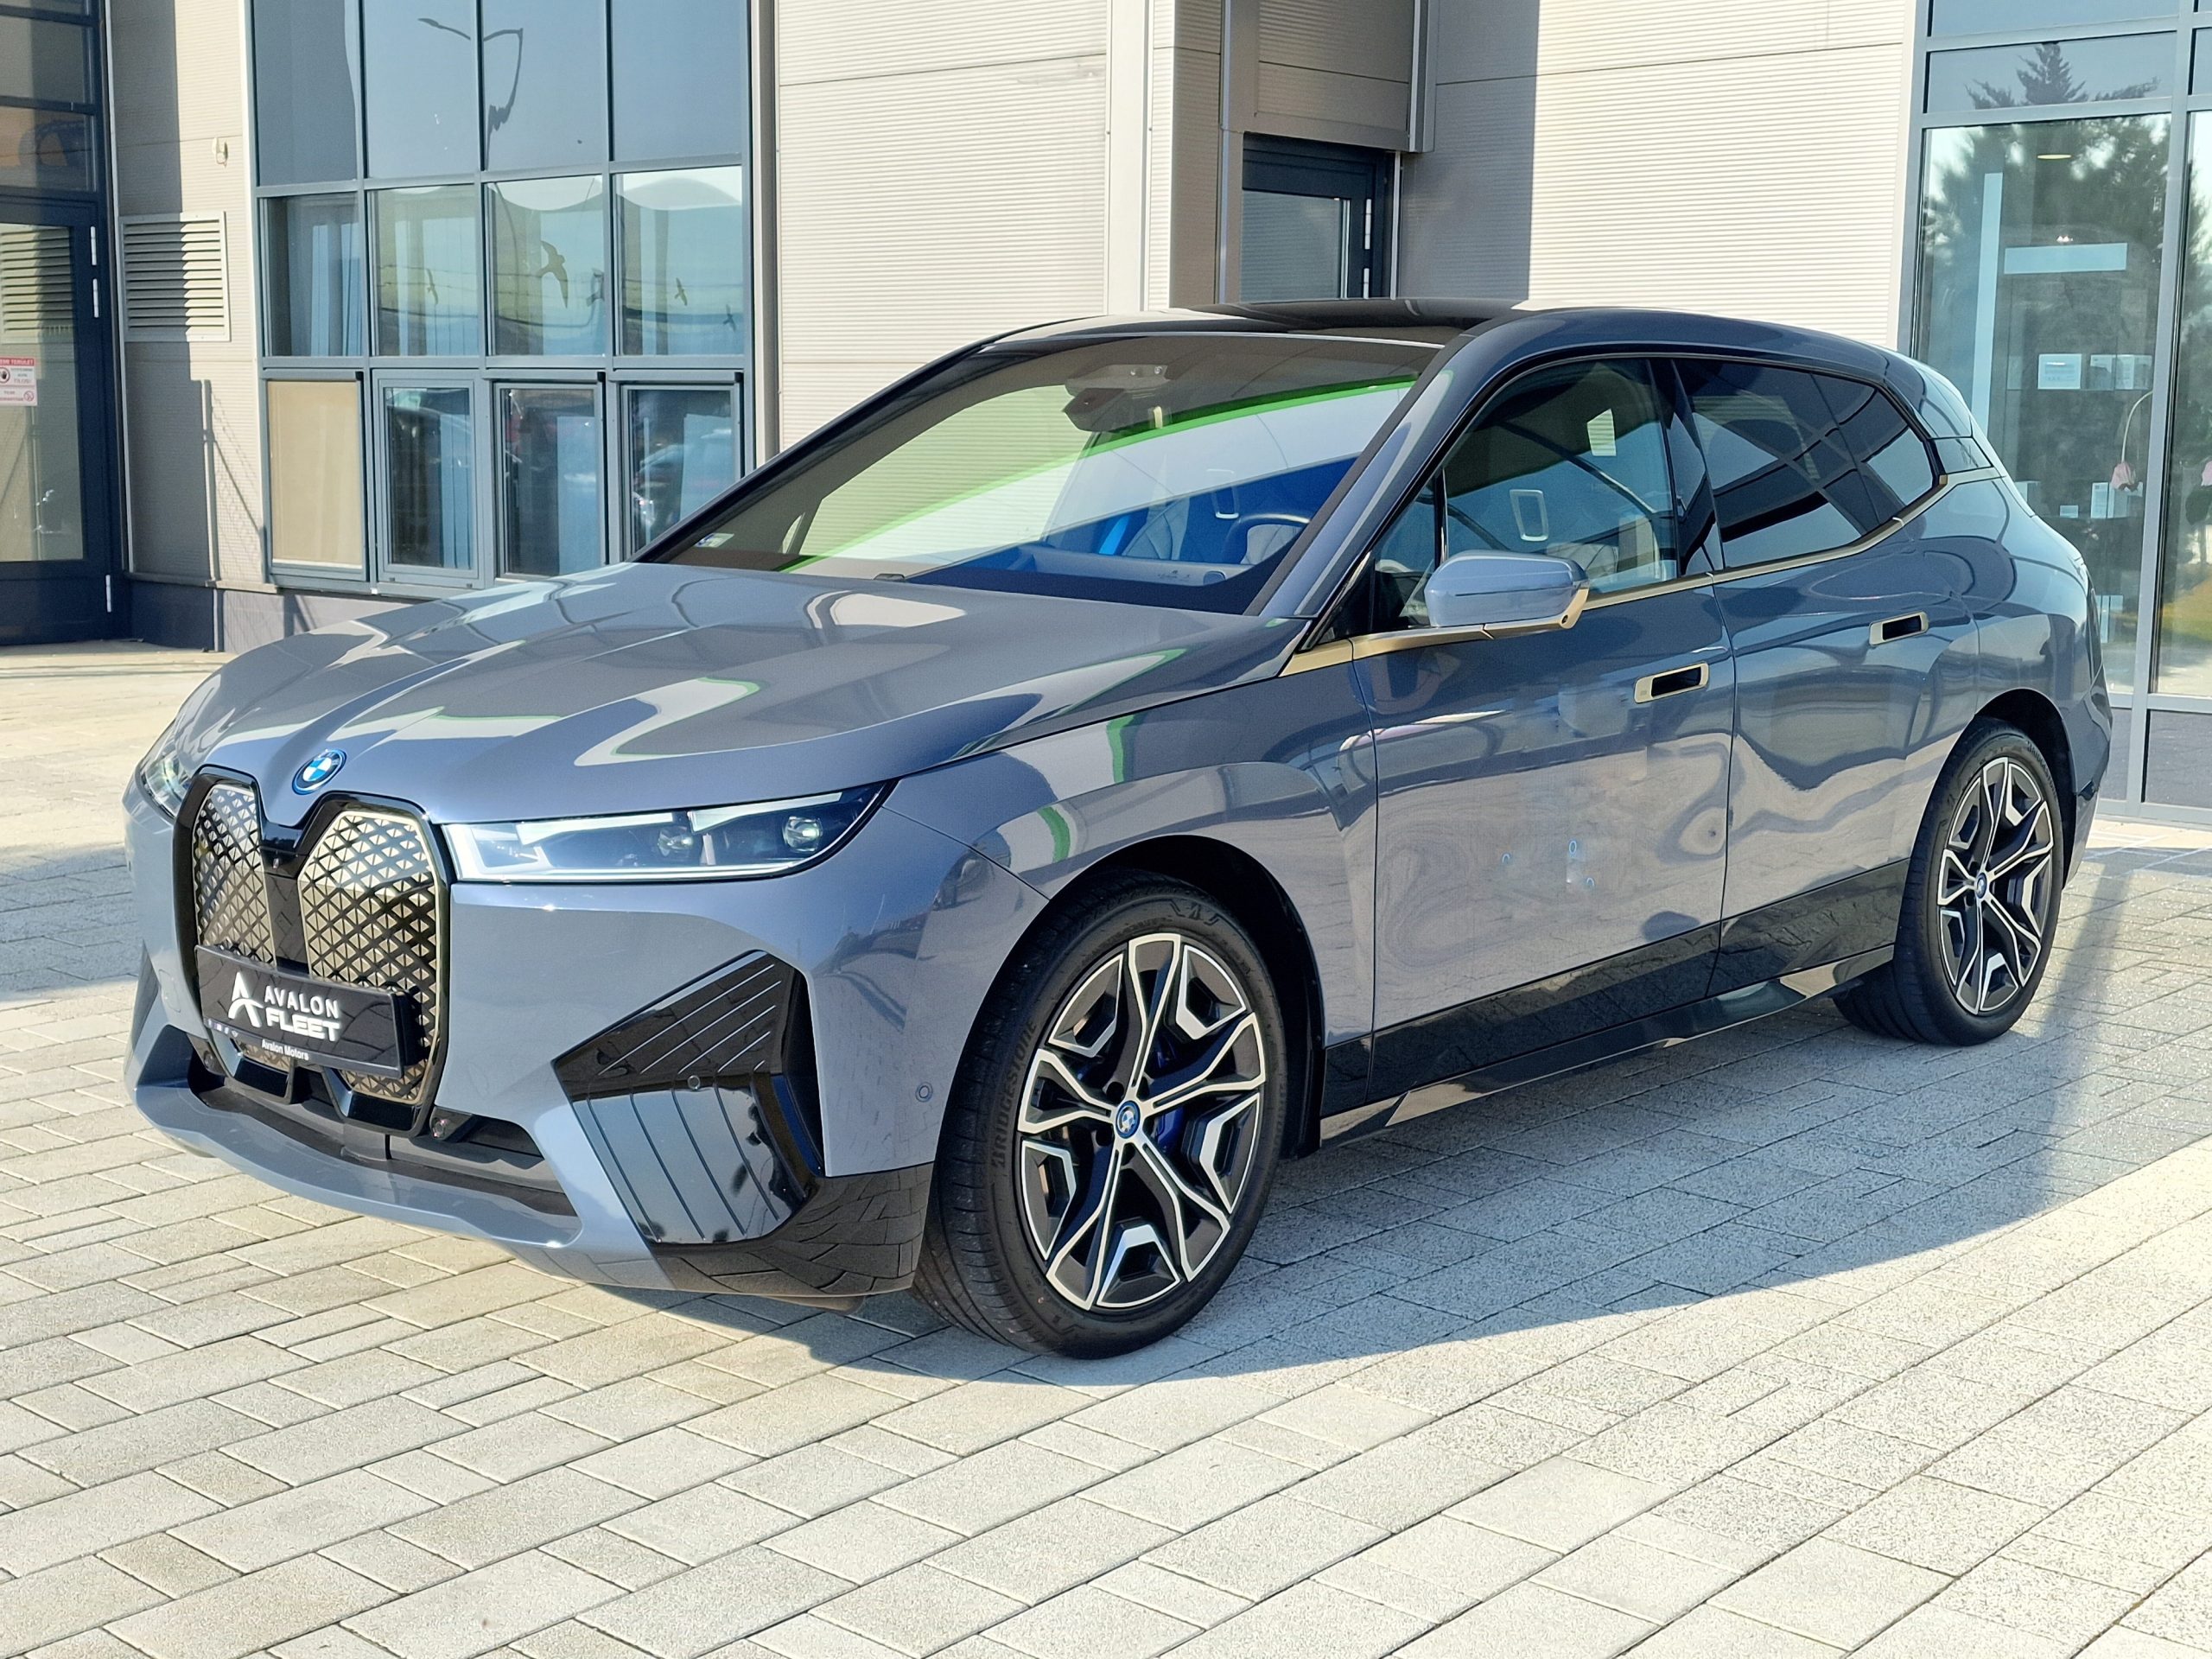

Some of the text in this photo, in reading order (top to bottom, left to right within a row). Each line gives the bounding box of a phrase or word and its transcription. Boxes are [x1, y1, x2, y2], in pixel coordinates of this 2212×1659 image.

[264, 985, 340, 1019] AVALON
[265, 1007, 342, 1042] FLEET
[261, 1039, 309, 1061] Avalon Motors
[991, 1020, 1037, 1168] BRIDGESTONE
